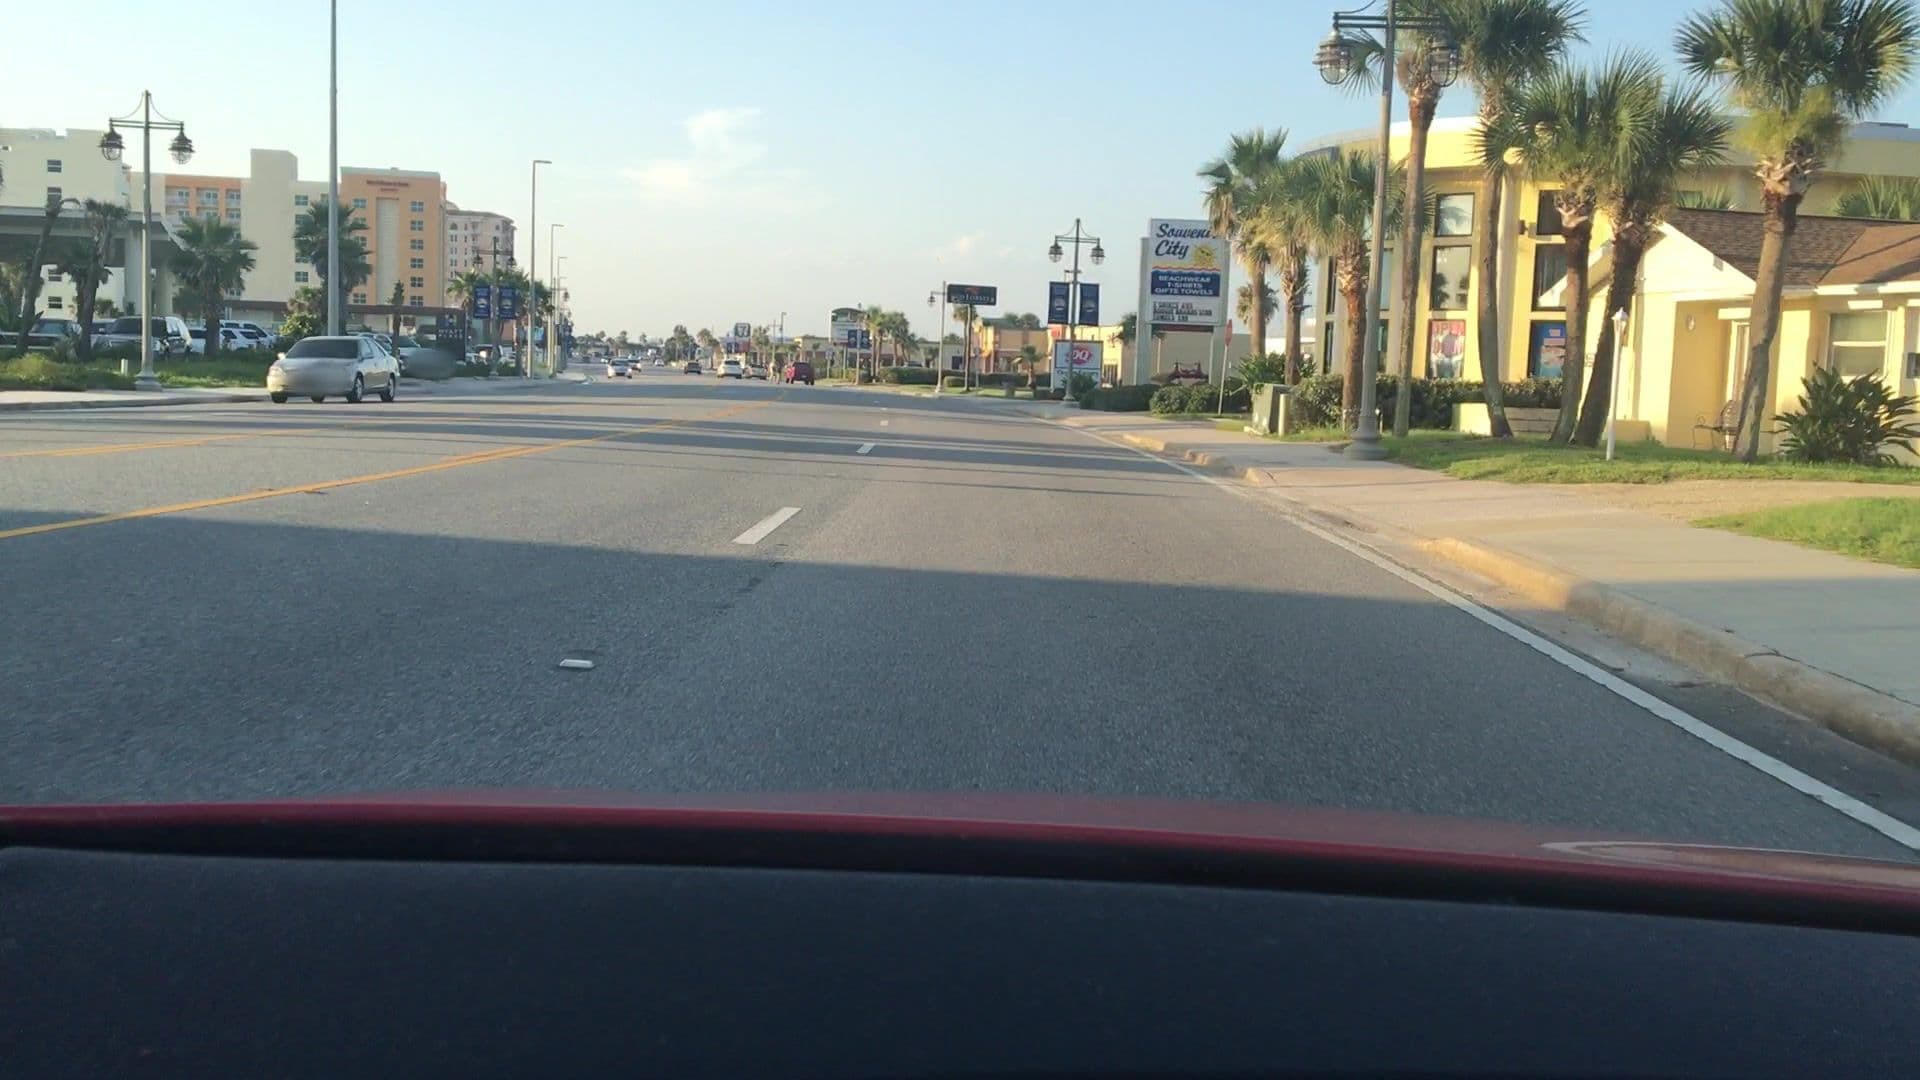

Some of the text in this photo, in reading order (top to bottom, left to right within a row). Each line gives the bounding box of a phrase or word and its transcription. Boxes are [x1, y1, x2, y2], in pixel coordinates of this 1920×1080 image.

[1156, 223, 1216, 239] Souveni
[1155, 240, 1189, 260] City
[1158, 275, 1211, 283] BEACHWEAR
[1154, 287, 1214, 296] GIFTS TOWELS
